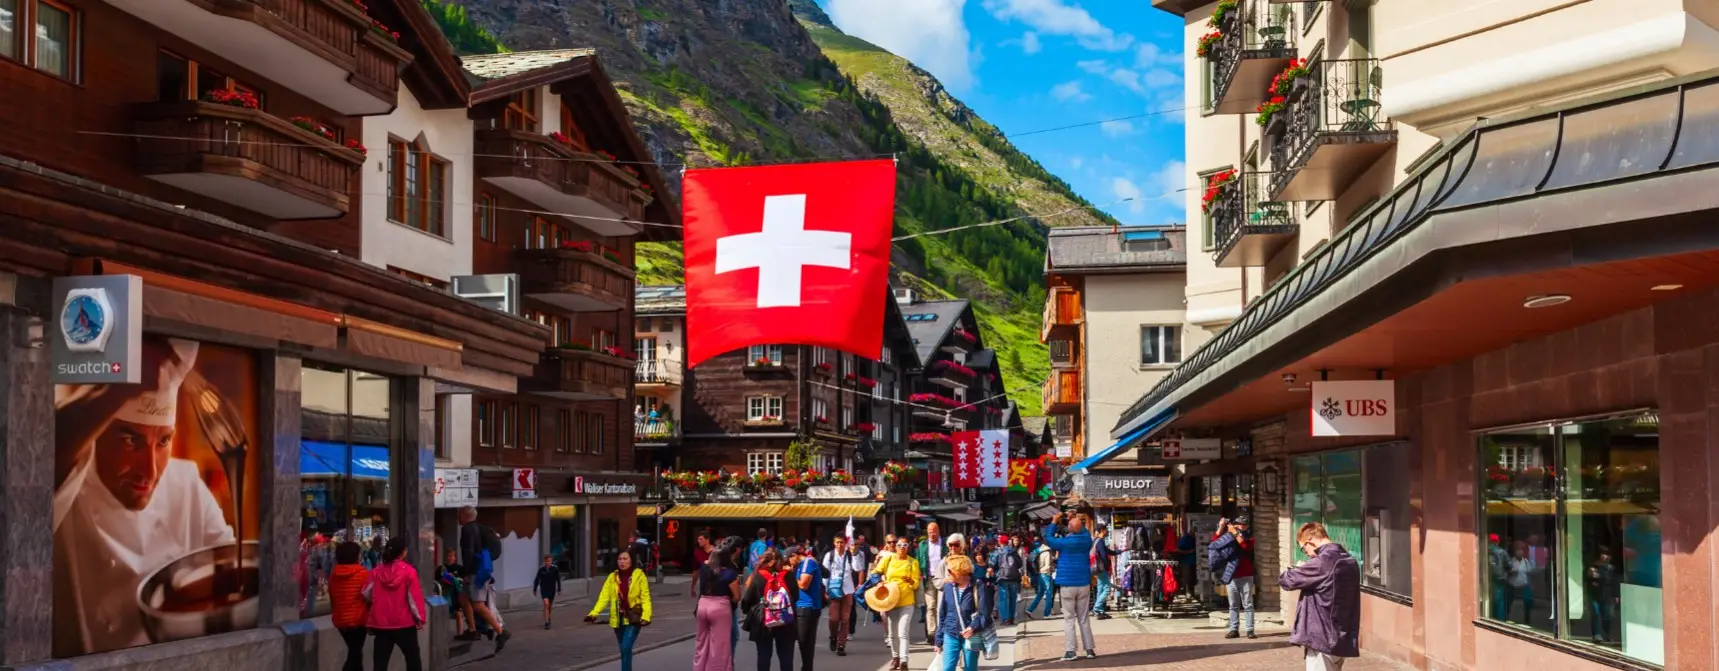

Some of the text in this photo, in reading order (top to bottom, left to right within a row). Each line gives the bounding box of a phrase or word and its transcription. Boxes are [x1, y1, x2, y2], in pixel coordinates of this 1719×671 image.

[58, 360, 111, 374] swatch
[1345, 399, 1388, 417] UBS
[584, 482, 636, 493] Walliser Kantonalbank
[1105, 479, 1152, 489] HUBLOT
